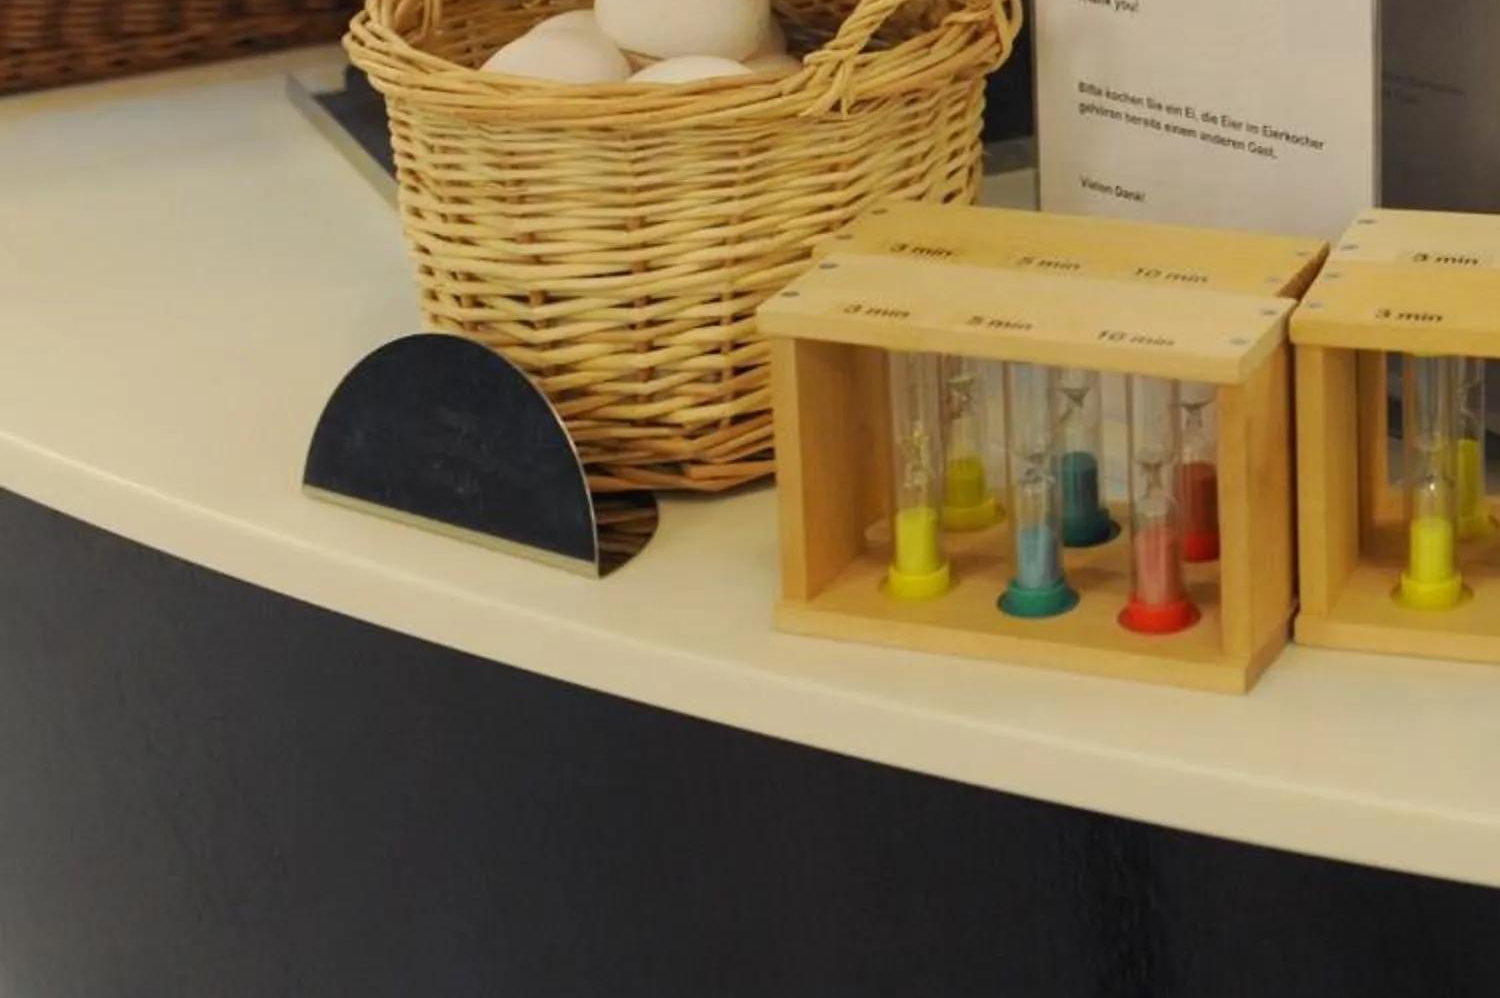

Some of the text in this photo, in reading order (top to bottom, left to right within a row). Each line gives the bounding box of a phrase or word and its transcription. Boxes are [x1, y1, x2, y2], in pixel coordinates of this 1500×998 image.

[1105, 89, 1144, 106] kochen
[1146, 97, 1163, 111] Sie
[1166, 104, 1182, 116] ein
[1200, 111, 1218, 125] die
[1221, 115, 1243, 132] Eier
[1246, 122, 1259, 134] im
[1262, 125, 1325, 150] Eierkocher
[1125, 113, 1162, 131] bereits
[1165, 122, 1197, 139] einem
[1200, 131, 1245, 150] anderen
[1080, 176, 1146, 203] Vielen Dank!
[913, 245, 955, 258] min
[1038, 259, 1082, 272] min
[1435, 255, 1480, 265] min
[1164, 271, 1209, 284] min
[866, 306, 910, 319] min
[1397, 311, 1444, 323] min
[990, 319, 1034, 331] min
[1131, 334, 1176, 347] min
